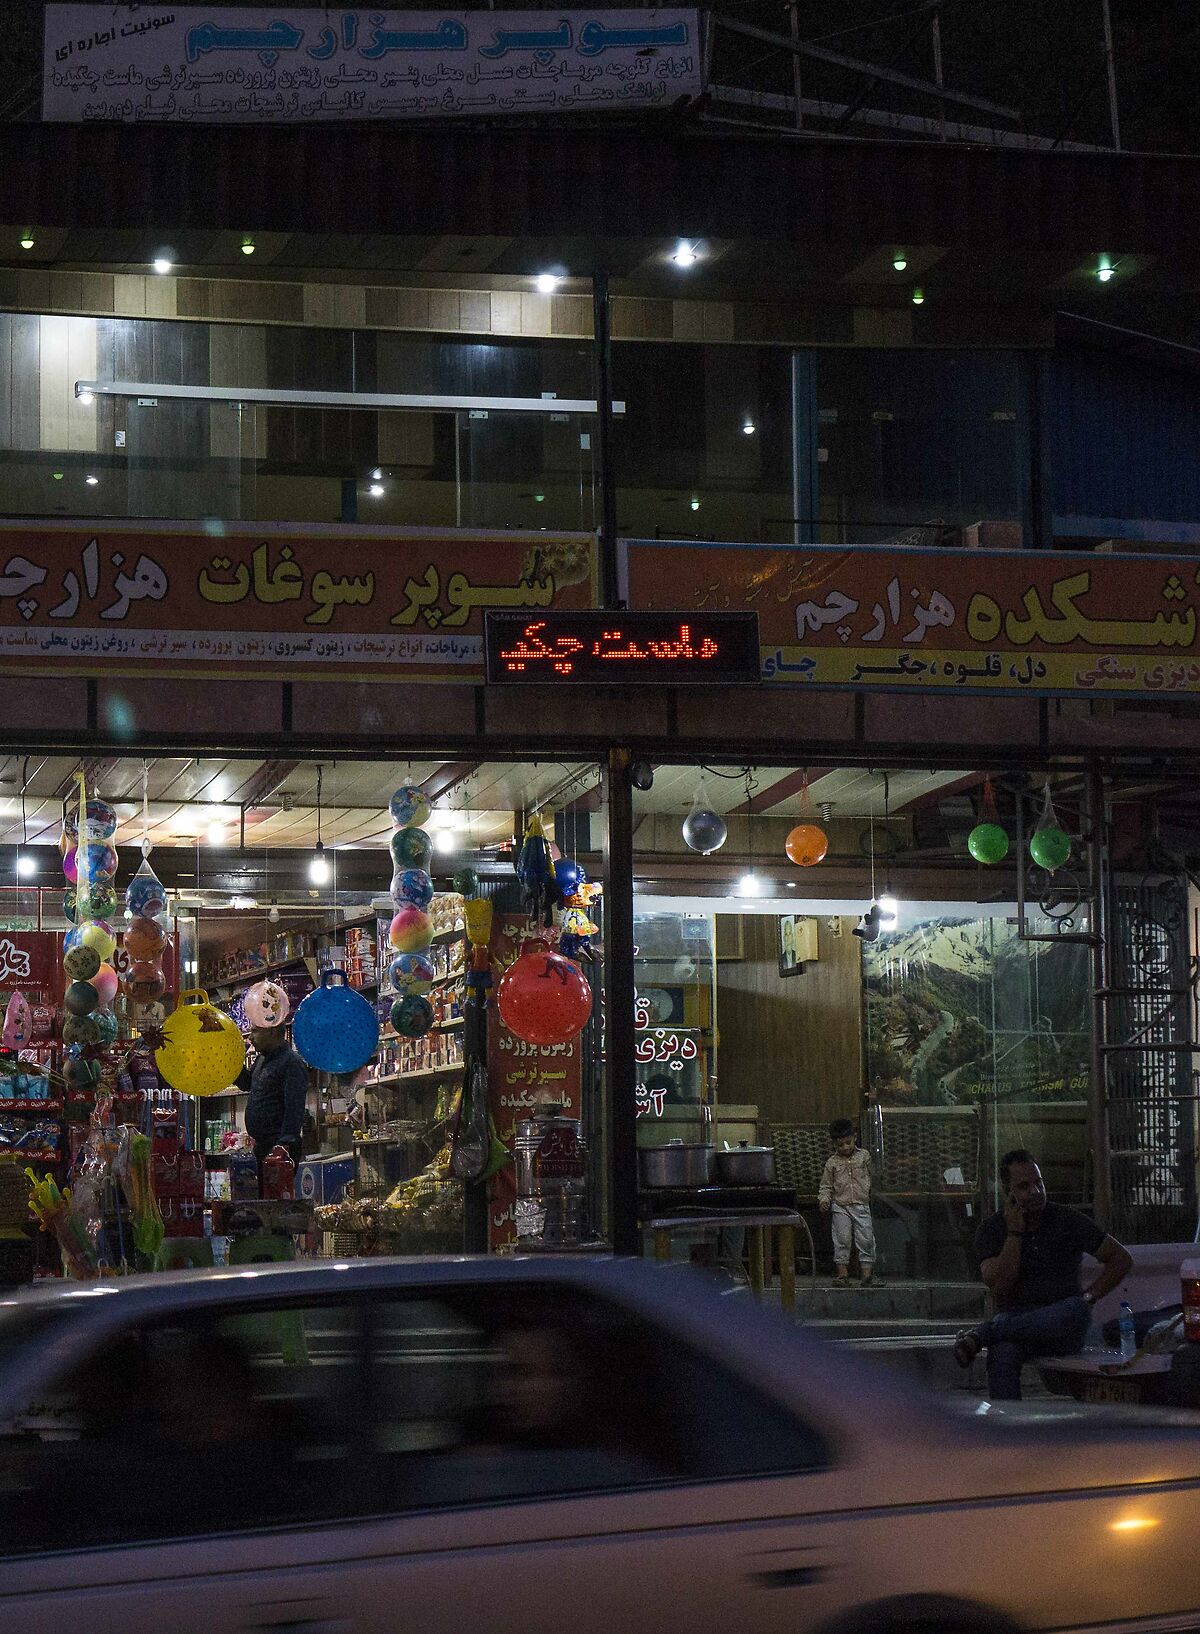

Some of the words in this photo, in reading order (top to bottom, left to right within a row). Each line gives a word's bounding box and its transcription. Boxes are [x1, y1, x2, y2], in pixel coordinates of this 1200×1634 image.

[479, 20, 688, 65] سوپر
[102, 64, 143, 86] ماست
[278, 66, 321, 89] زیتون
[323, 64, 378, 88] محلی
[422, 63, 464, 86] محلی
[467, 63, 513, 85] عسل
[606, 57, 650, 79] کلوچه
[654, 56, 693, 79] انواع
[178, 92, 232, 119] محلی
[559, 86, 613, 107] محلی
[198, 541, 376, 625] سوغات
[390, 563, 554, 629] سوپر
[965, 566, 1200, 646] شکده
[943, 654, 1002, 683] قلوه
[1075, 655, 1137, 688] سنگی
